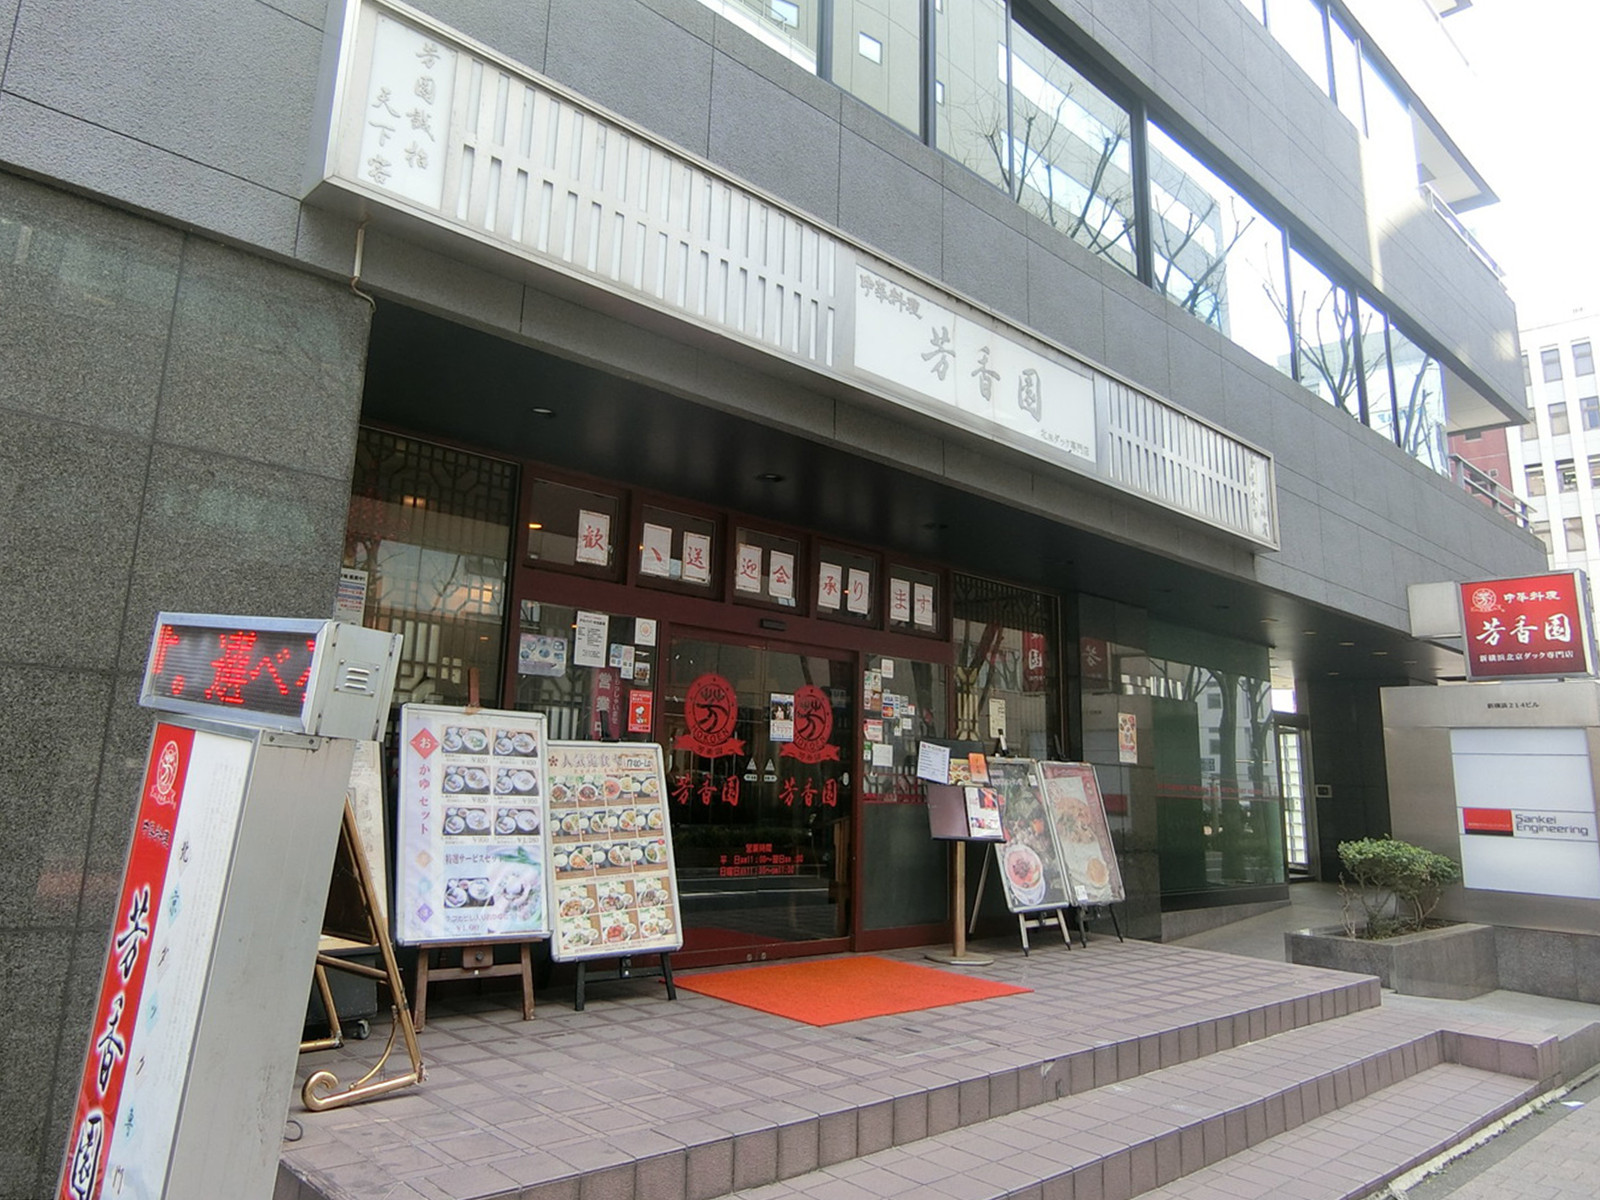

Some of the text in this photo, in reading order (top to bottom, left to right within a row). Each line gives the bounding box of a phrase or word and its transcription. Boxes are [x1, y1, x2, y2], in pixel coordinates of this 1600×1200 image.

[921, 326, 1042, 423] 芳香園
[1475, 613, 1571, 646] 芳香園
[418, 737, 432, 836] おかゆセット
[672, 774, 740, 806] 芳香園
[779, 776, 838, 807] 芳香園
[1515, 814, 1556, 824] Sankei
[1516, 822, 1588, 836] Engineering
